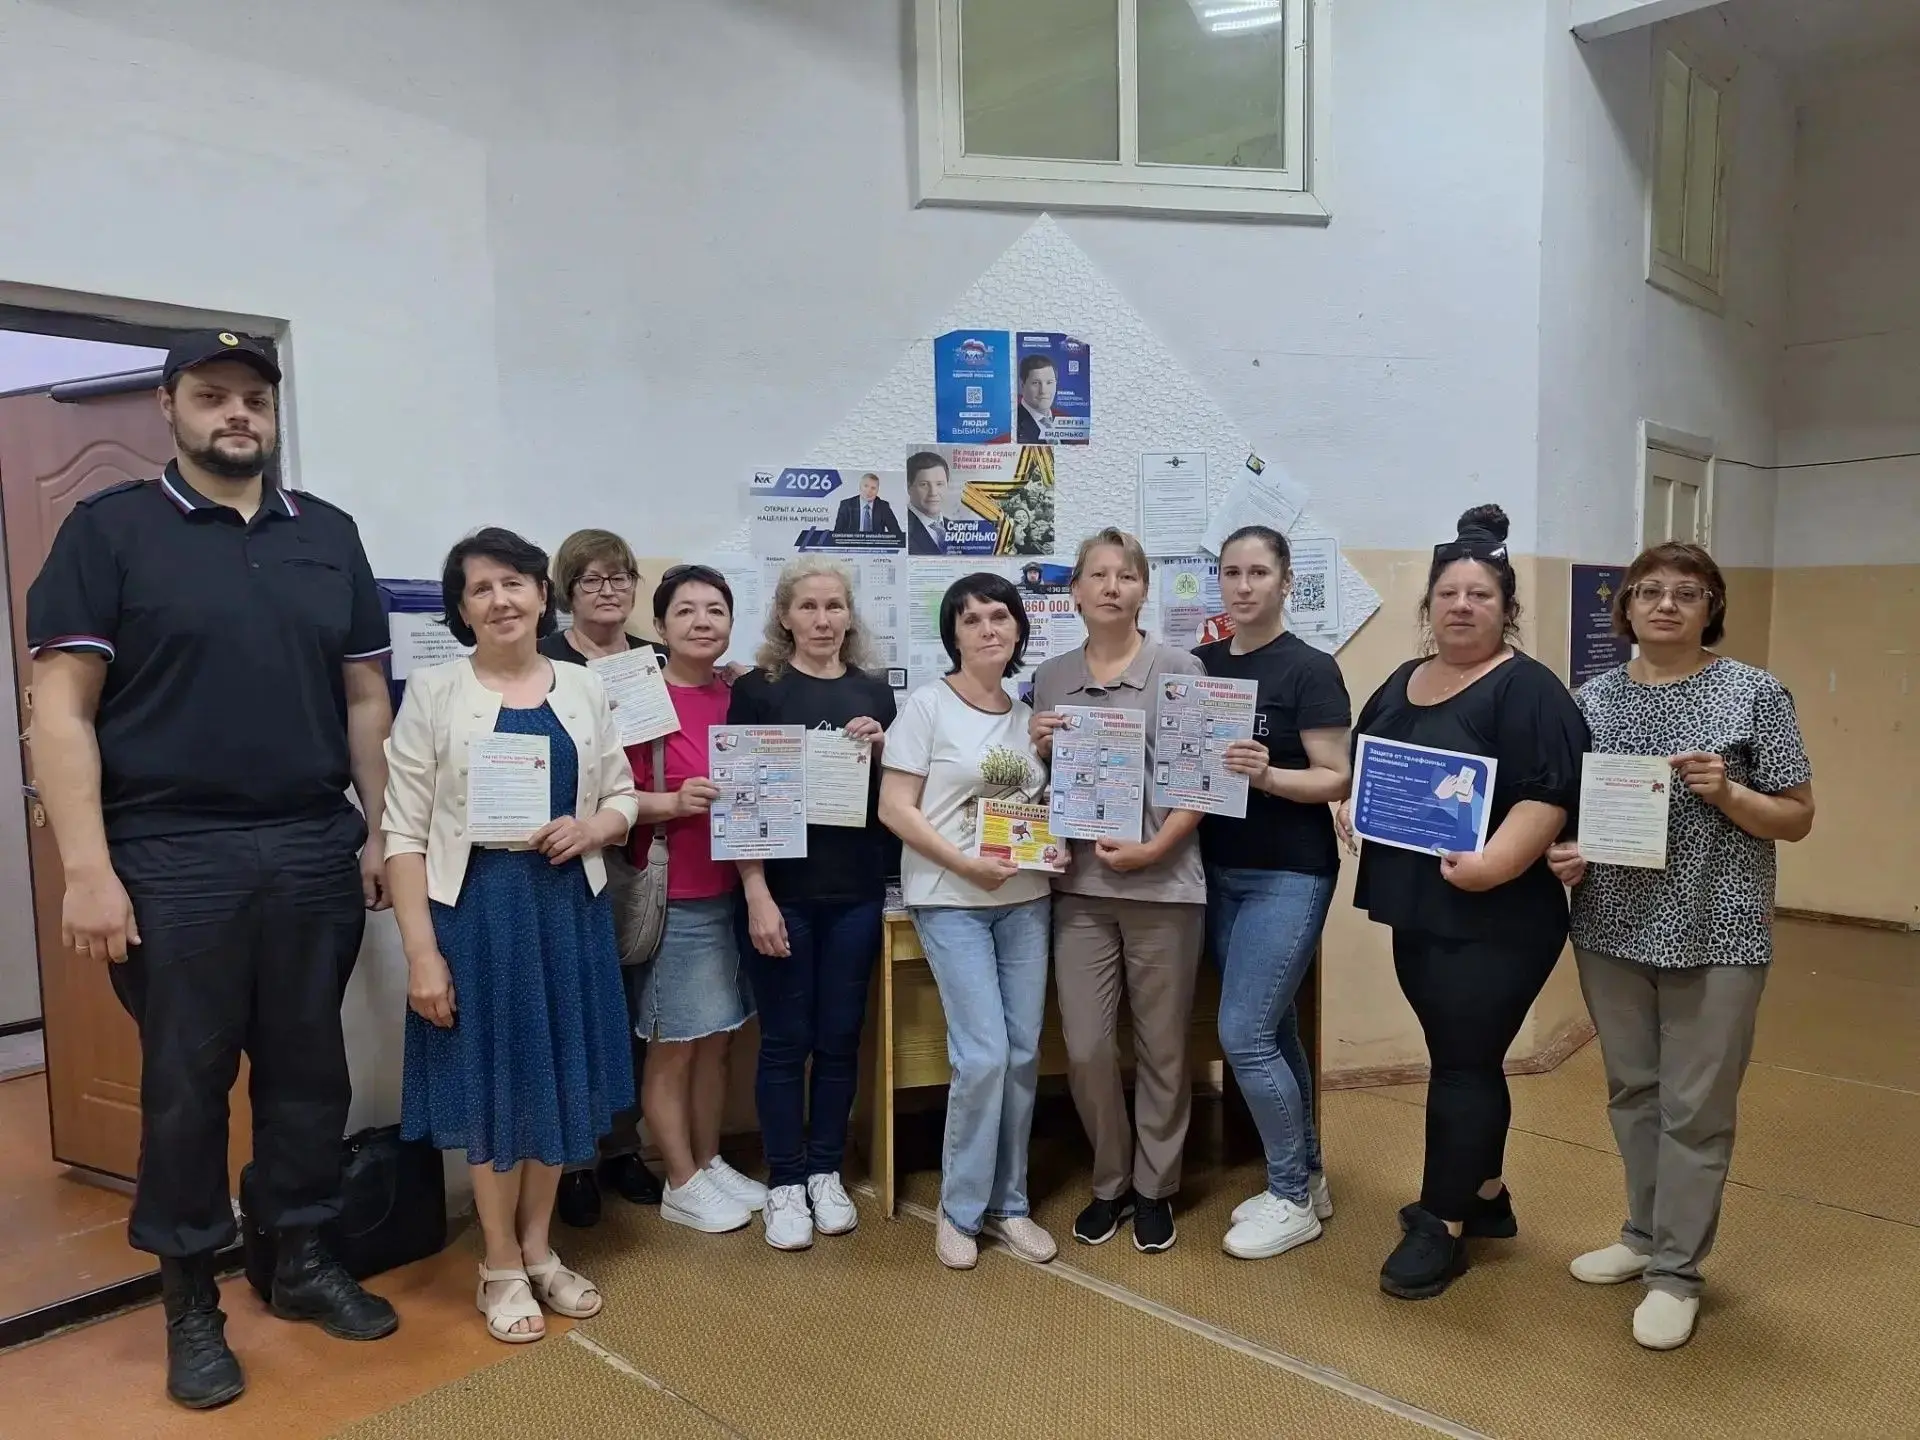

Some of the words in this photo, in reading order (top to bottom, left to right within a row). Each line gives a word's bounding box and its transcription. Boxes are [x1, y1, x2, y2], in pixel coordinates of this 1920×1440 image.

[786, 473, 832, 490] 2026
[764, 505, 789, 513] ОТКРЫТ
[797, 506, 829, 514] ДИАЛОГУ
[947, 521, 978, 533] Сергей
[945, 532, 998, 543] БИДОНЬКО
[1024, 600, 1045, 613] 860
[1049, 600, 1070, 613] 000
[1369, 747, 1393, 758] Защита
[1403, 755, 1447, 768] телефонных
[992, 802, 1050, 814] ВНИМАНИ
